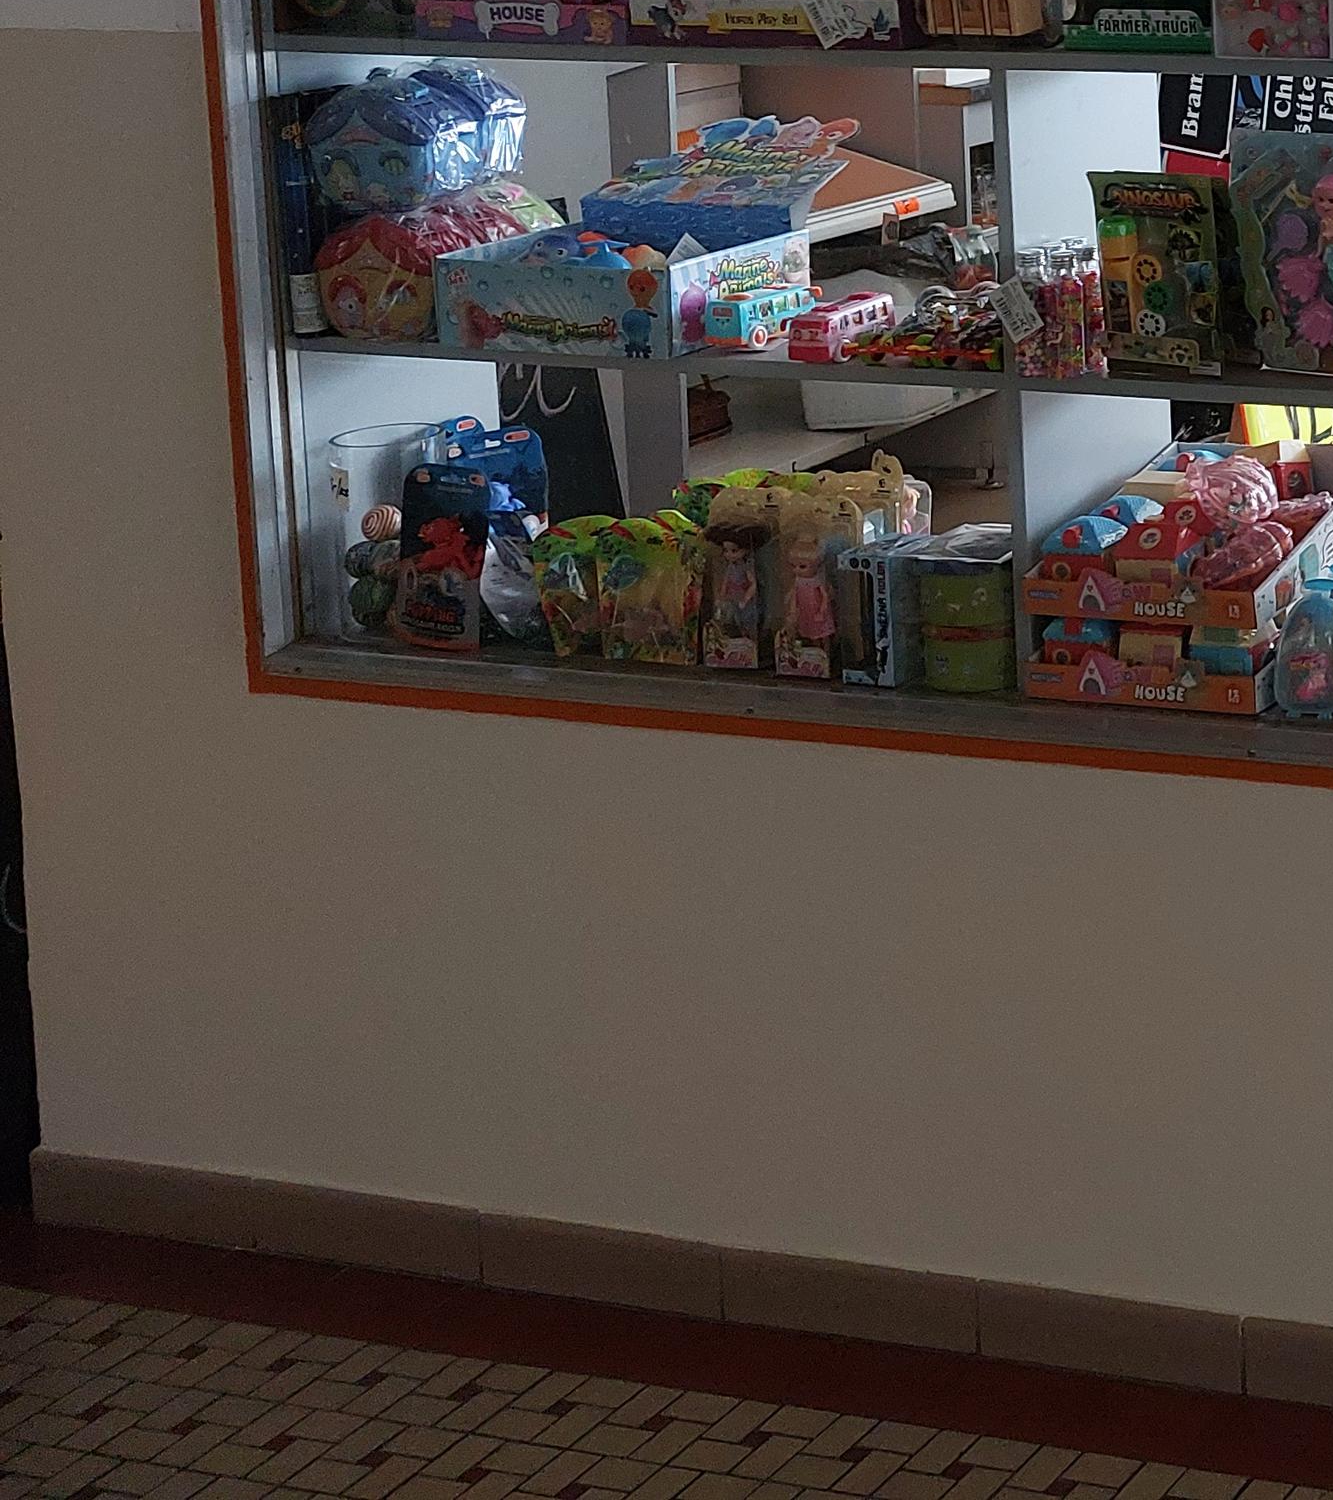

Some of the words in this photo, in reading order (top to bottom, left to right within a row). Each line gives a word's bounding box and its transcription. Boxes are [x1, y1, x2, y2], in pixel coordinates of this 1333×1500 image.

[488, 6, 546, 25] HOUSE
[1097, 17, 1146, 34] FARMER
[1149, 18, 1199, 35] TRUCK
[719, 257, 769, 282] Marine
[1133, 600, 1186, 619] HOUSE
[1134, 683, 1186, 702] HOUSE
